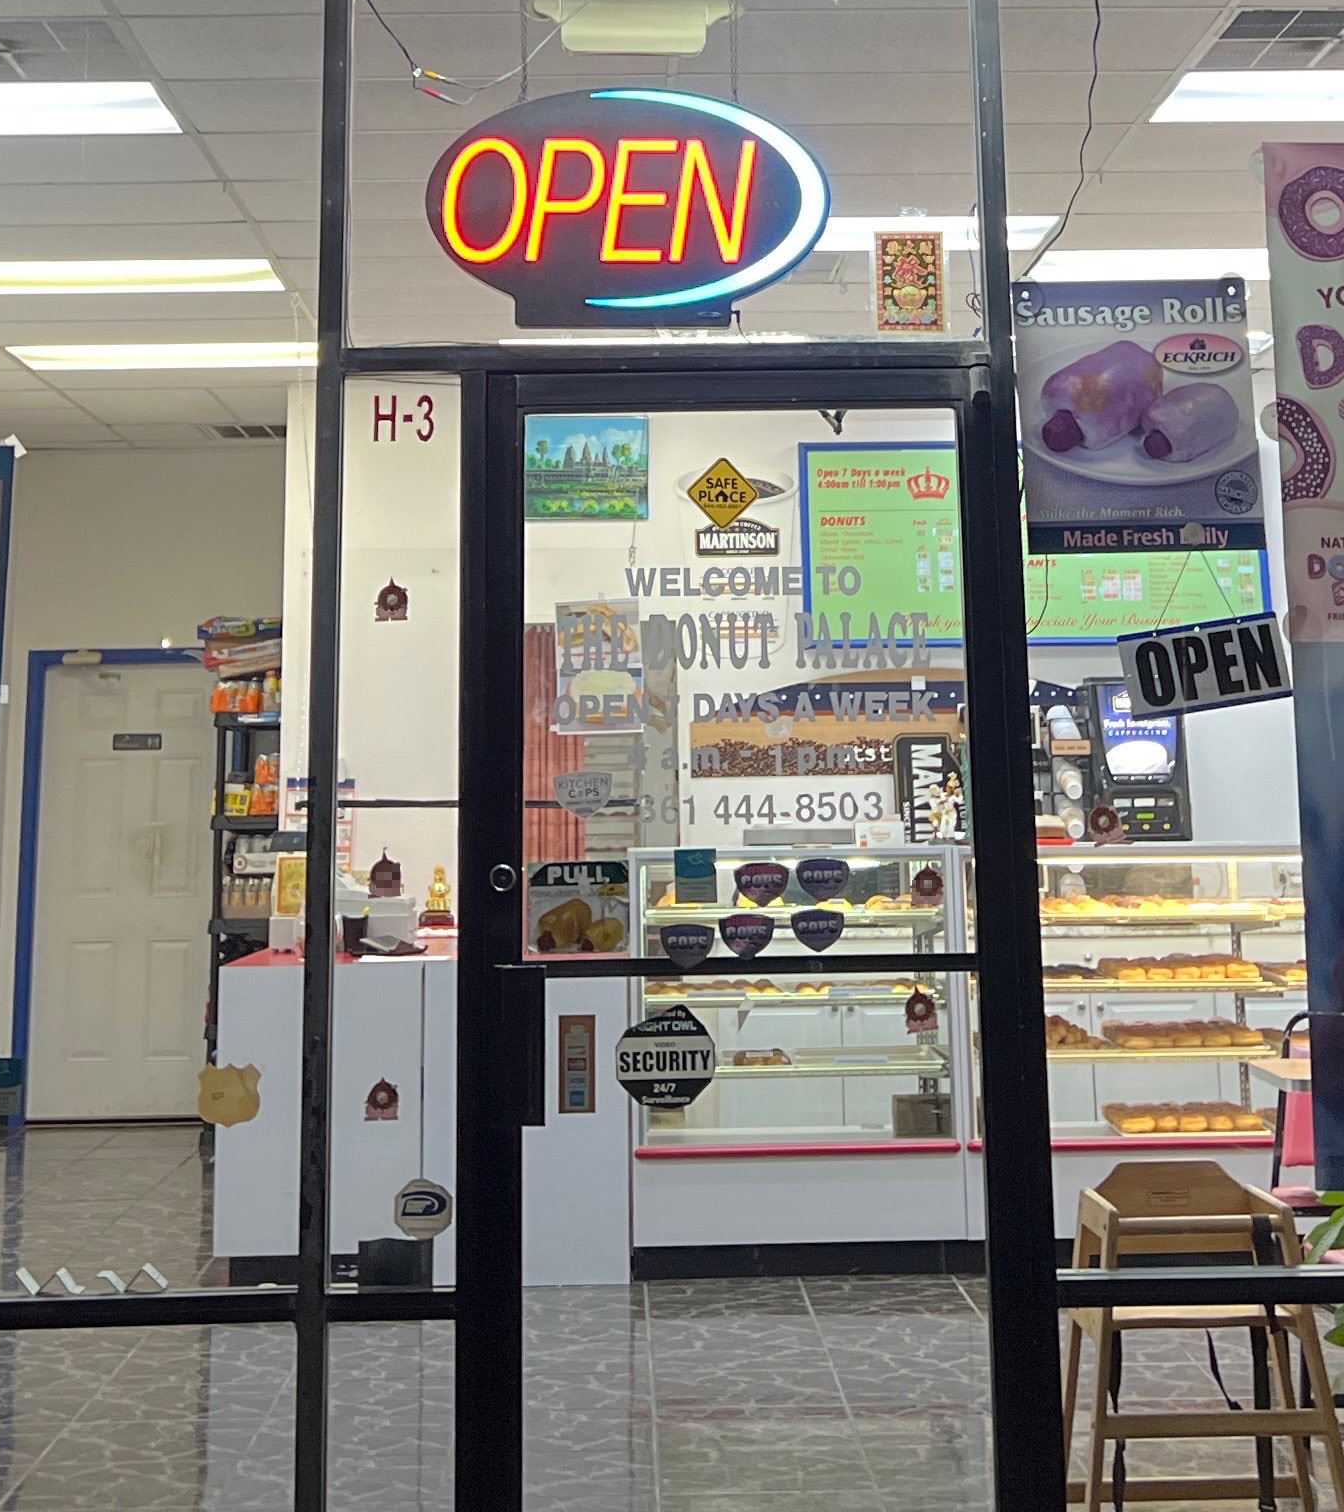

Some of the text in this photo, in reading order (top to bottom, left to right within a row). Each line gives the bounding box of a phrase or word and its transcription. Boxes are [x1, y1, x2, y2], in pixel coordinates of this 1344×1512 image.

[441, 137, 756, 265] OPEN
[1016, 296, 1242, 332] Sausage Rolls
[1162, 351, 1236, 364] ECKRICH
[373, 394, 434, 442] H-3
[706, 477, 739, 489] SAFE
[1076, 508, 1095, 518] the
[1099, 507, 1153, 518] Moment
[819, 516, 866, 526] DONUTS
[699, 532, 776, 549] MARTINSON
[1063, 529, 1117, 548] Made
[1123, 528, 1175, 546] Fresh
[626, 565, 862, 597] WELCOME TO
[557, 612, 932, 670] THE DONUT PALACE
[1135, 623, 1282, 707] OPEN
[553, 694, 650, 725] OPEN
[693, 692, 781, 724] DAYS
[793, 692, 818, 723] A
[828, 691, 938, 723] WEEK
[557, 776, 609, 789] KITCHEN
[712, 790, 885, 825] 444-8503
[741, 873, 783, 888] COPS
[802, 869, 843, 884] COPS
[725, 925, 767, 939] COPS
[797, 919, 839, 934] COPS
[667, 935, 708, 950] COPS
[619, 1049, 711, 1073] SECURITY
[653, 1083, 676, 1093] 24/7
